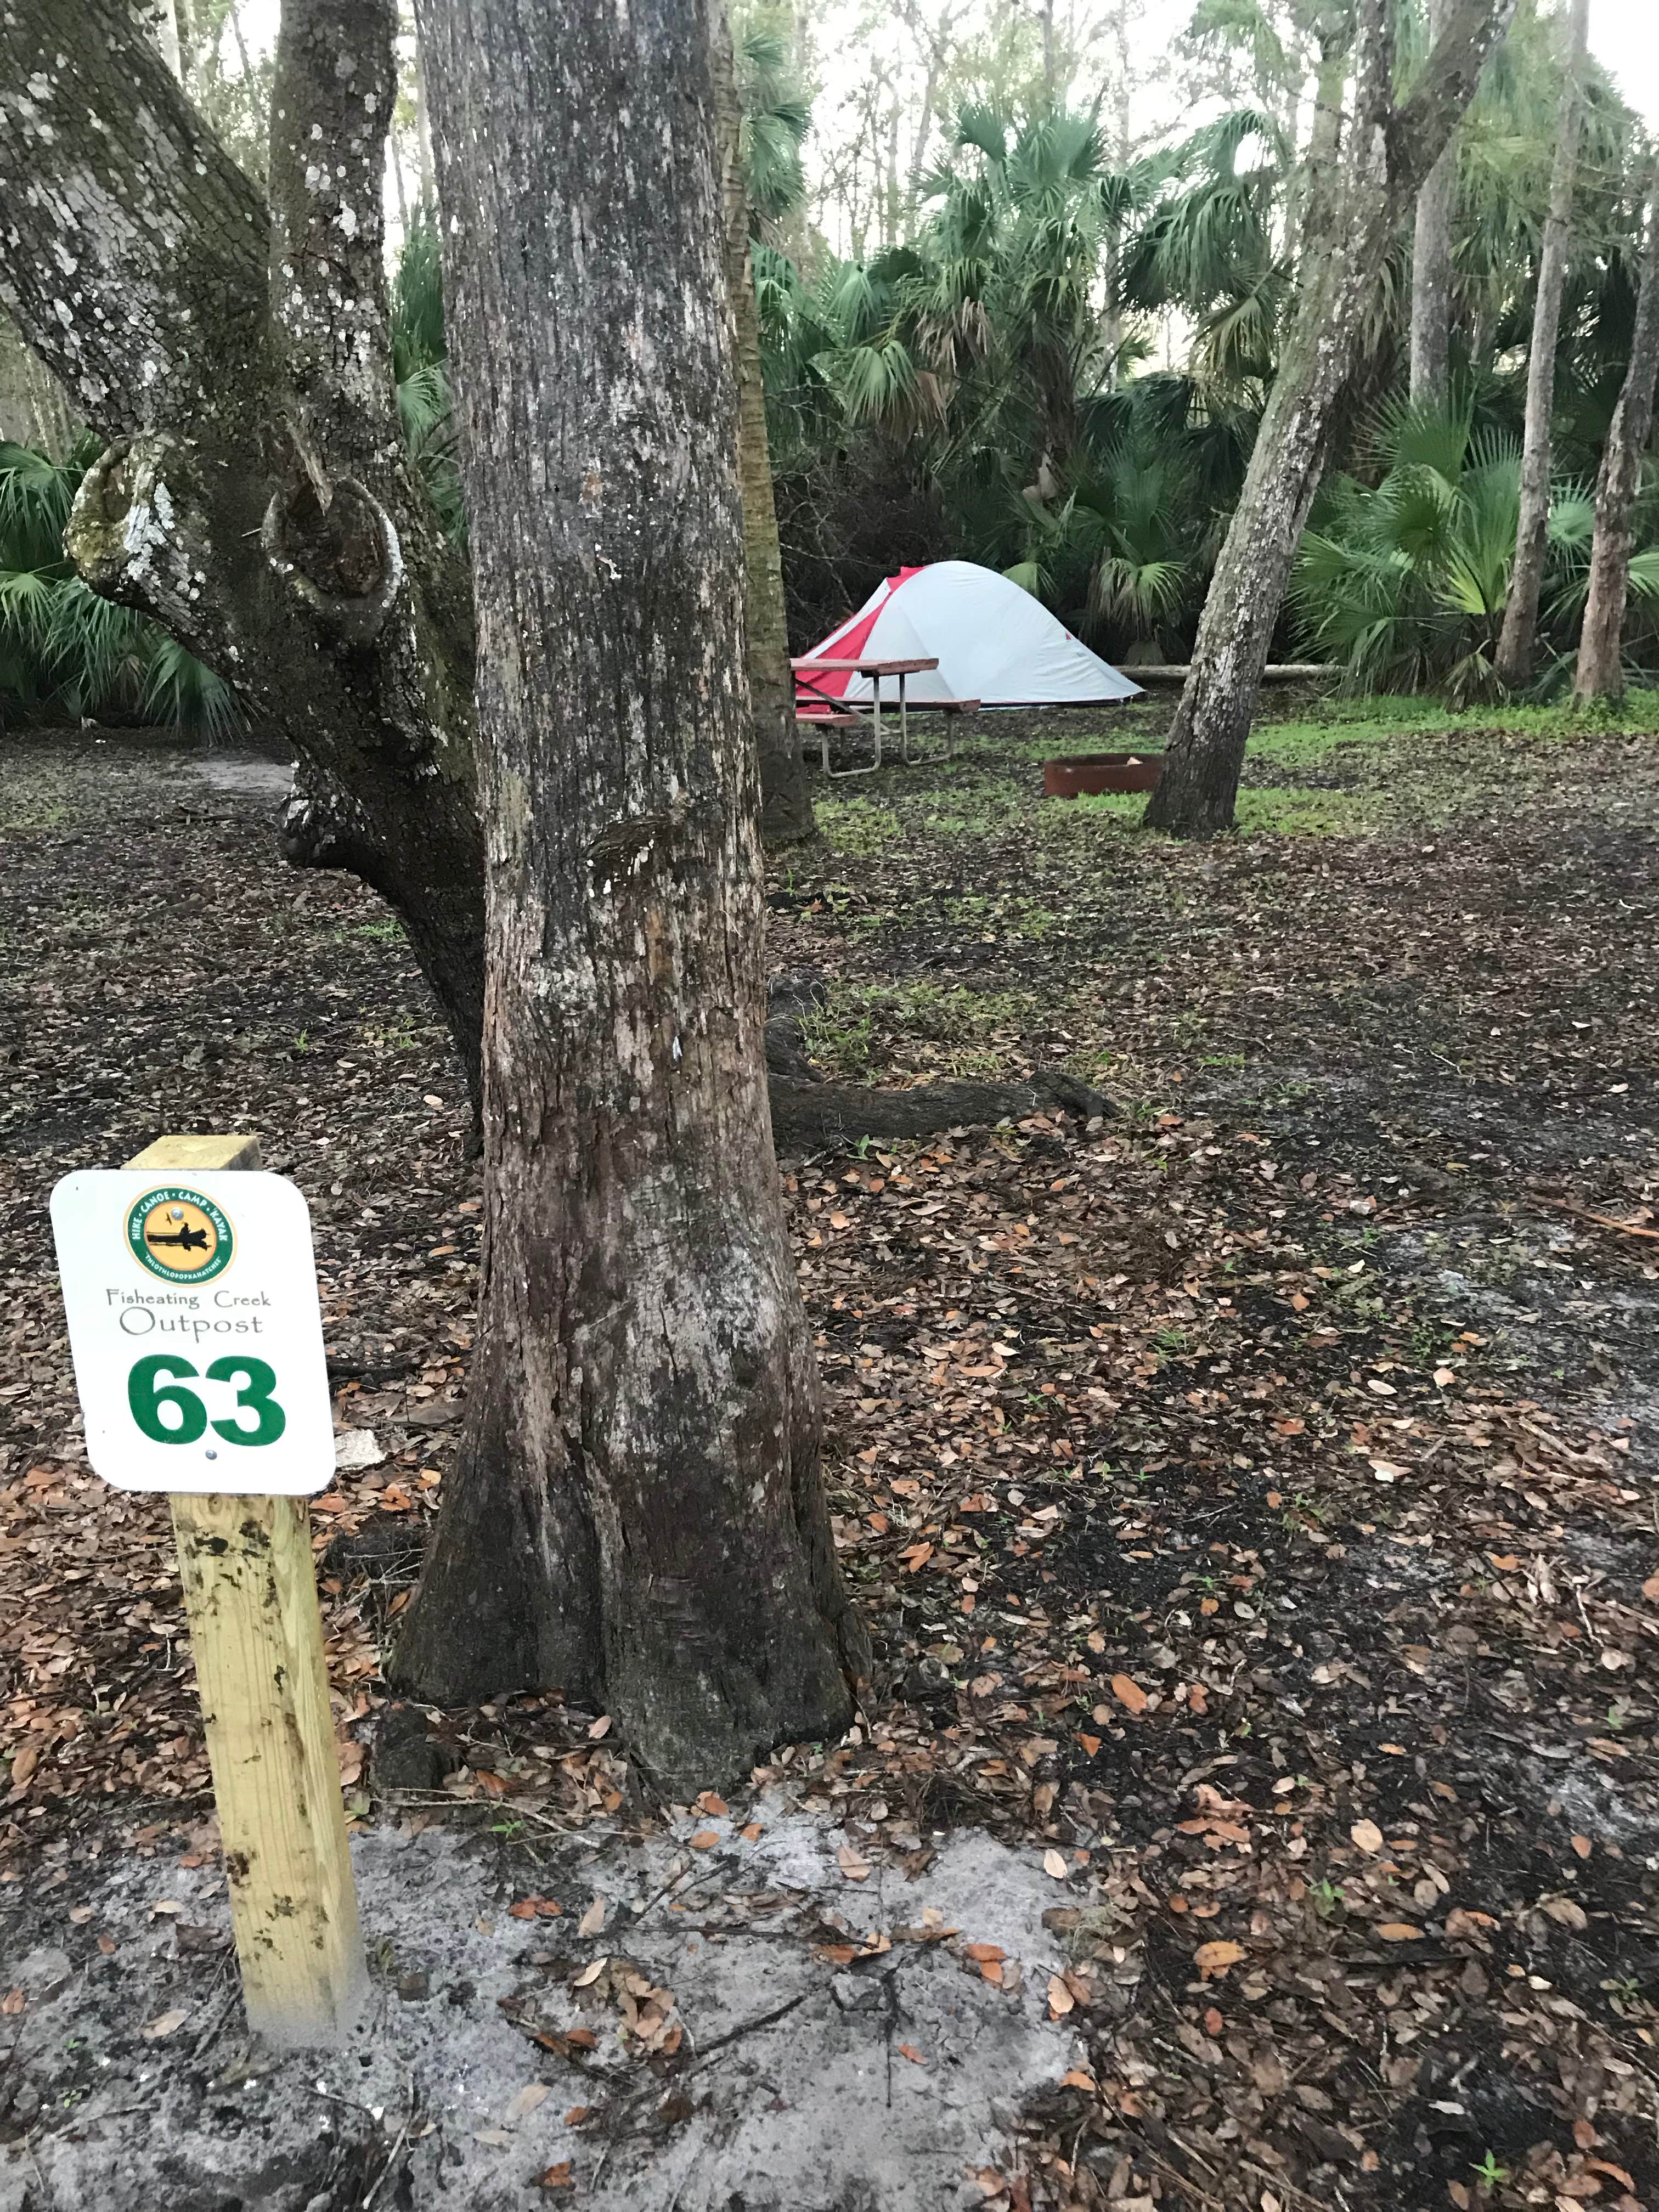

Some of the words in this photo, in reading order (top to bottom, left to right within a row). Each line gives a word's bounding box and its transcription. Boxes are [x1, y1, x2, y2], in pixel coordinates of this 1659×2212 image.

[131, 1217, 143, 1240] HIKE
[140, 1191, 170, 1213] CANOE
[178, 1191, 207, 1207] CAMP
[210, 1210, 228, 1241] KAYAK
[106, 1289, 200, 1310] Fisheating
[214, 1290, 272, 1308] Creek
[119, 1306, 263, 1344] Outpost
[128, 1354, 286, 1447] 63
